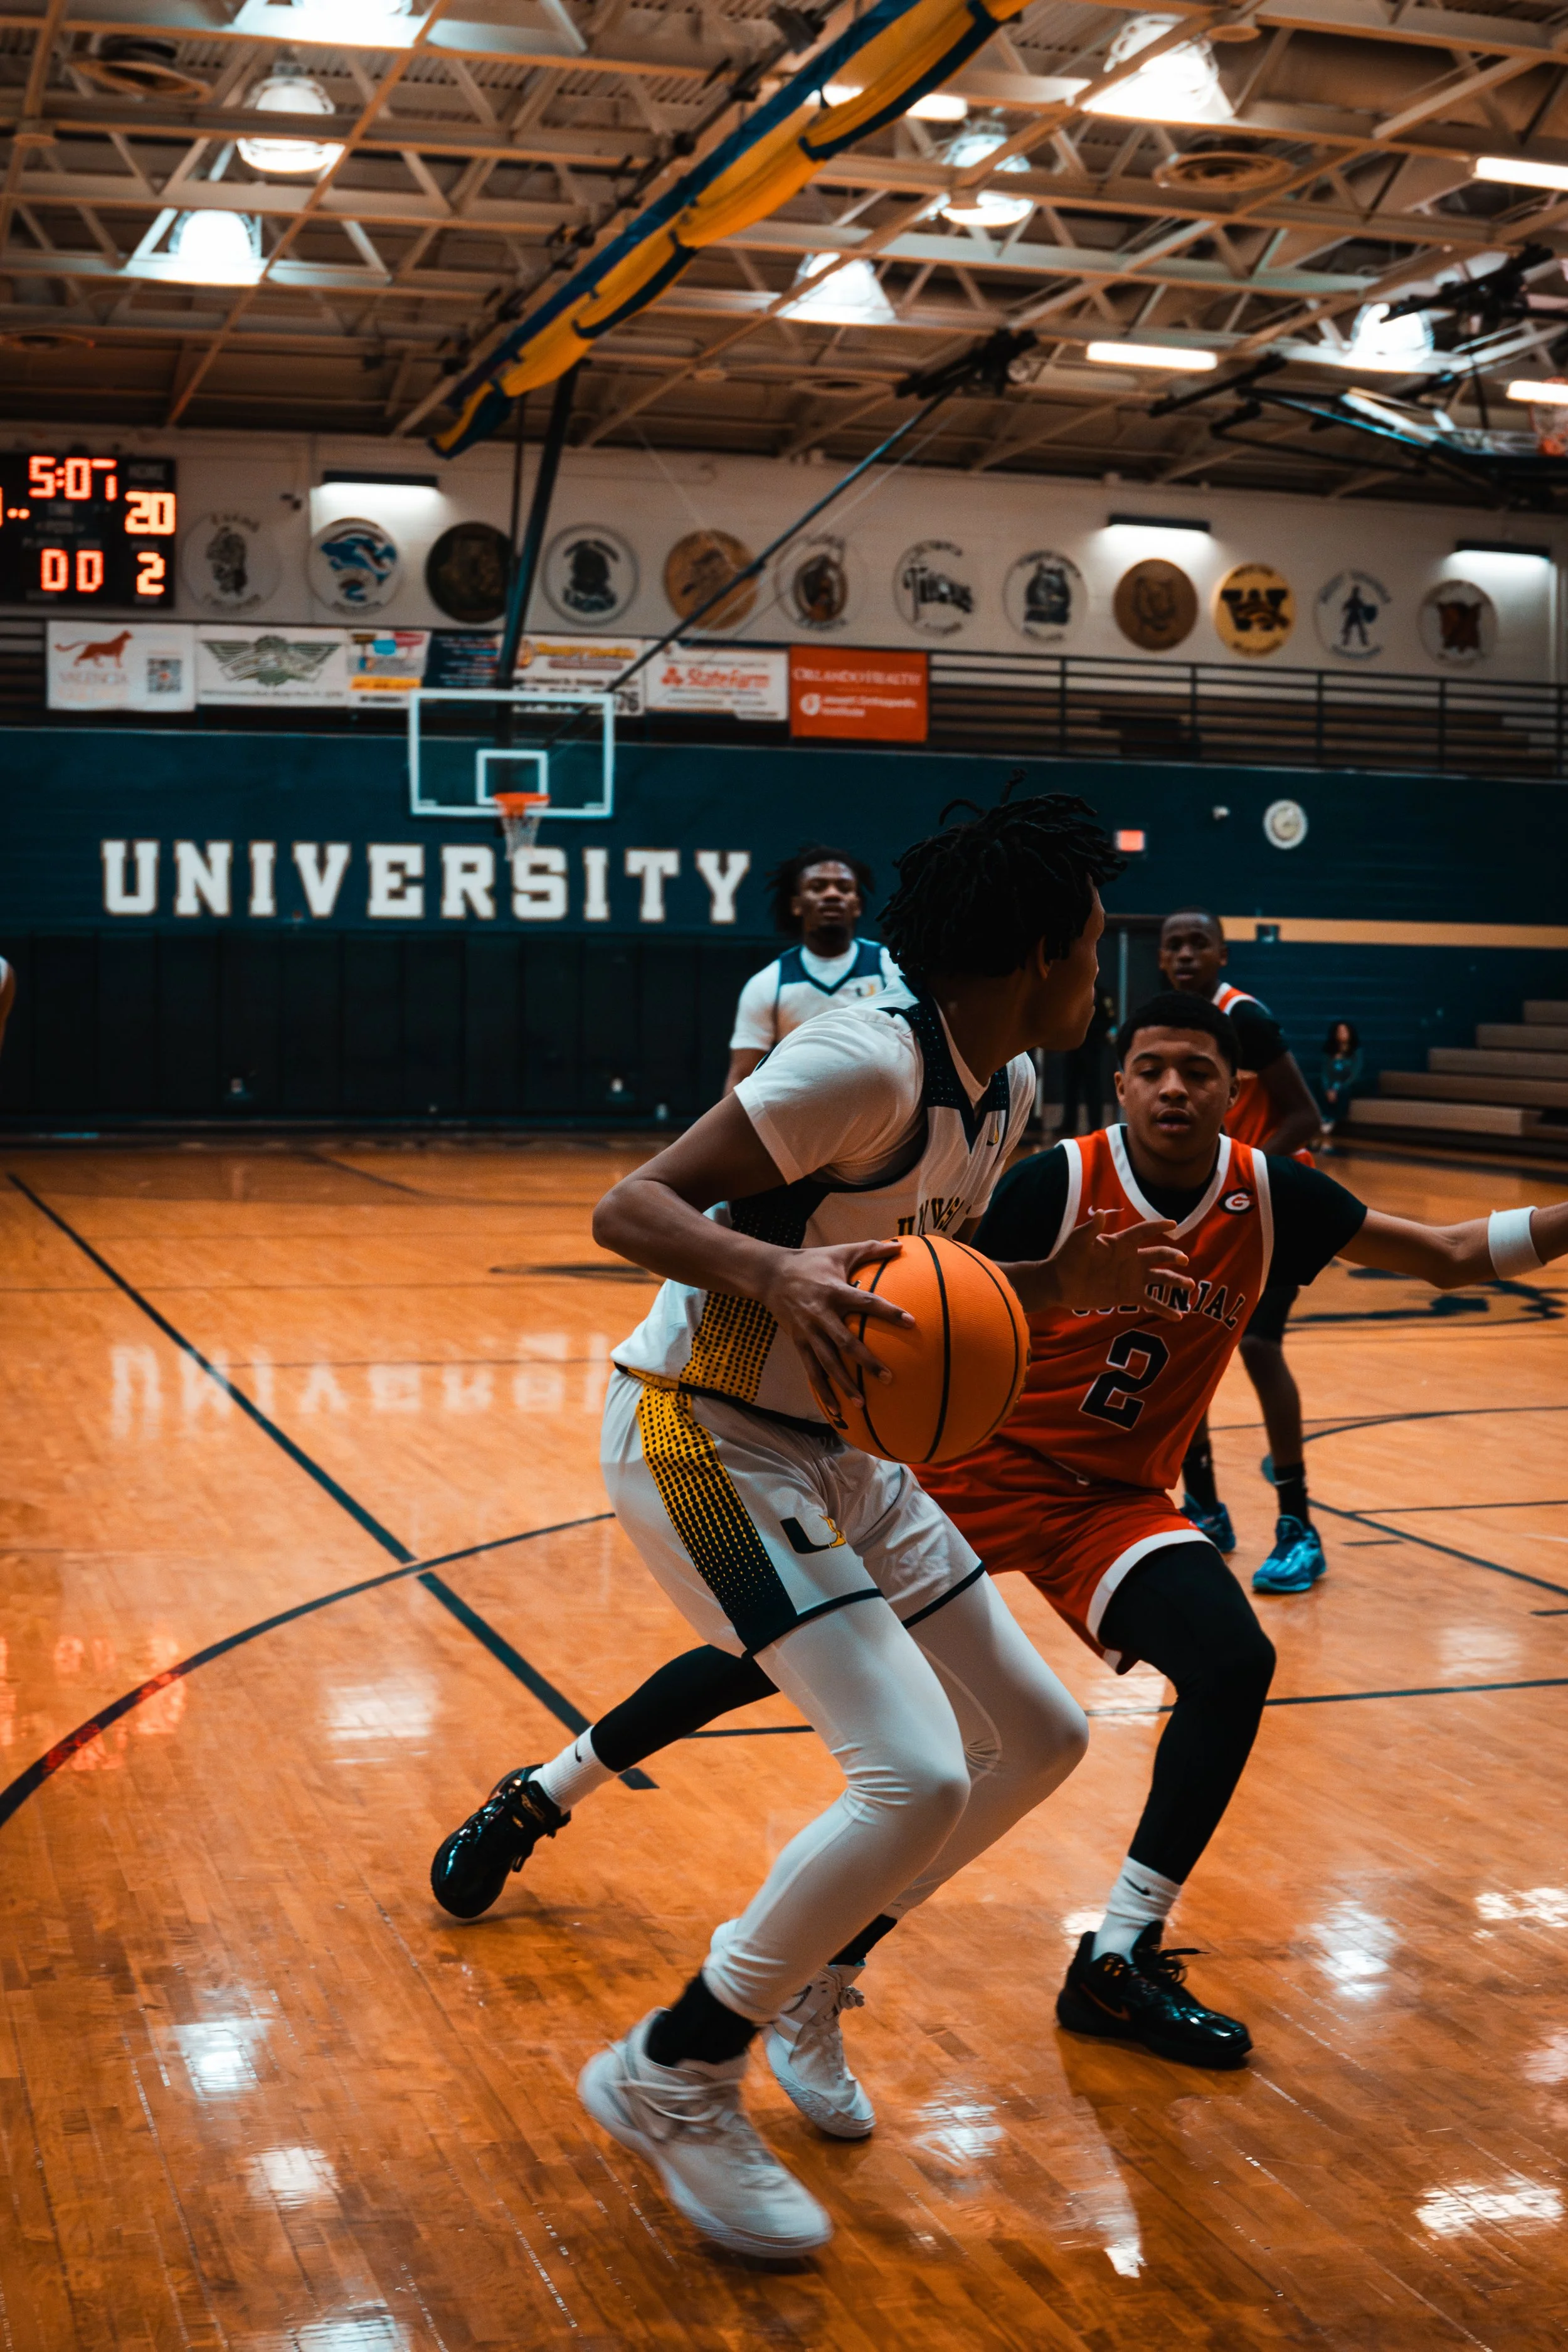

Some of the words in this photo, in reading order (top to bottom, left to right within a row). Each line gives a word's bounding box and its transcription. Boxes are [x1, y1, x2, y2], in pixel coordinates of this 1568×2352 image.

[28, 455, 118, 501] 5:07
[125, 490, 176, 535] 20
[136, 552, 165, 595] 2
[100, 838, 751, 924] UNIVERSITY
[1225, 1192, 1250, 1210] G
[1078, 1328, 1170, 1431] 2
